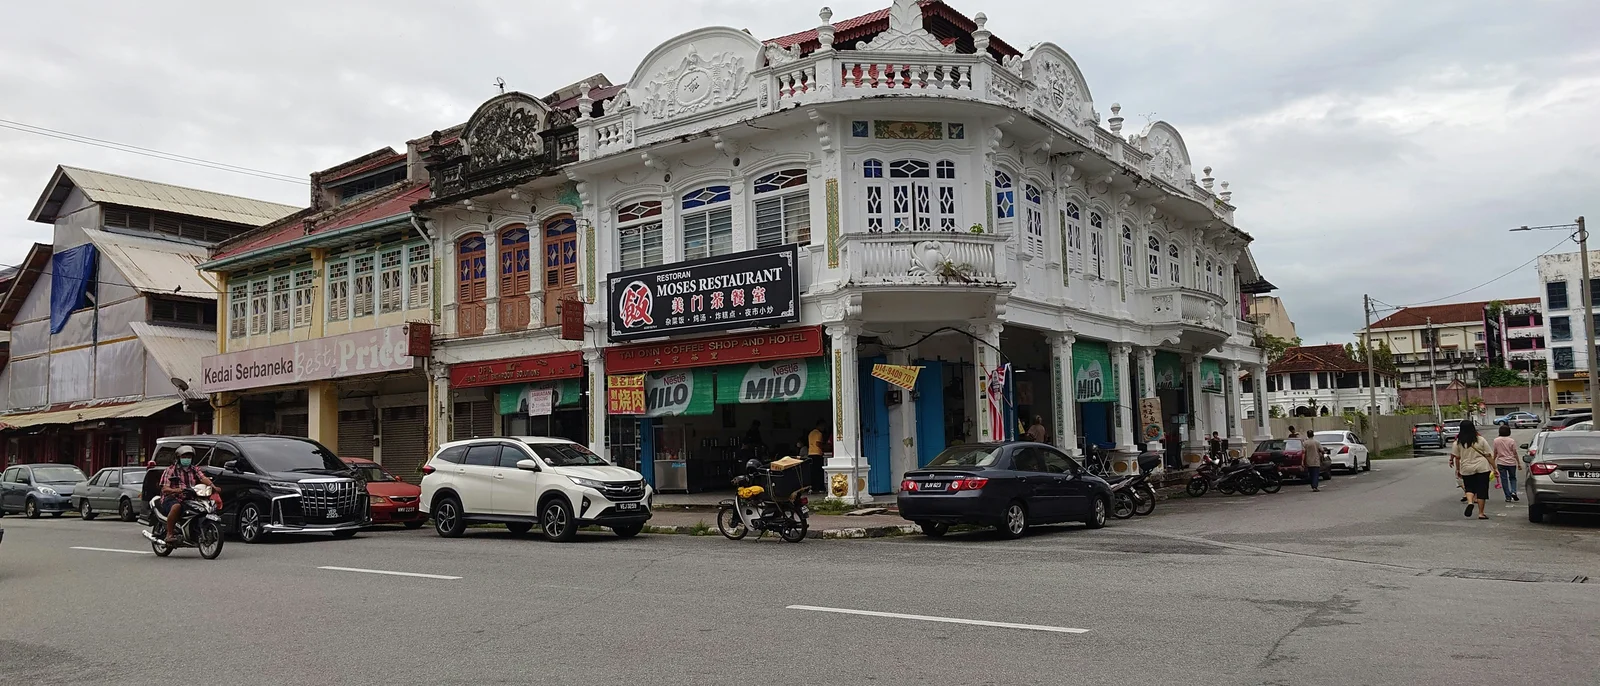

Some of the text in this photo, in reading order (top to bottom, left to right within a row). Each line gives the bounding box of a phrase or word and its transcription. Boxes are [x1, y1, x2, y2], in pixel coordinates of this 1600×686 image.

[656, 270, 691, 282] RESTORAN
[656, 267, 783, 298] MOSES RESTAURANT
[671, 286, 766, 315] 美门茶餐室
[619, 333, 808, 360] TAI ONN COFFEE SHOP AND HOTEL
[204, 364, 233, 385] Kedai
[235, 357, 294, 379] Serbaneka
[338, 335, 408, 374] Price
[516, 369, 540, 378] SOLUTIONS
[745, 373, 801, 399] MILO
[1077, 378, 1102, 399] MILO
